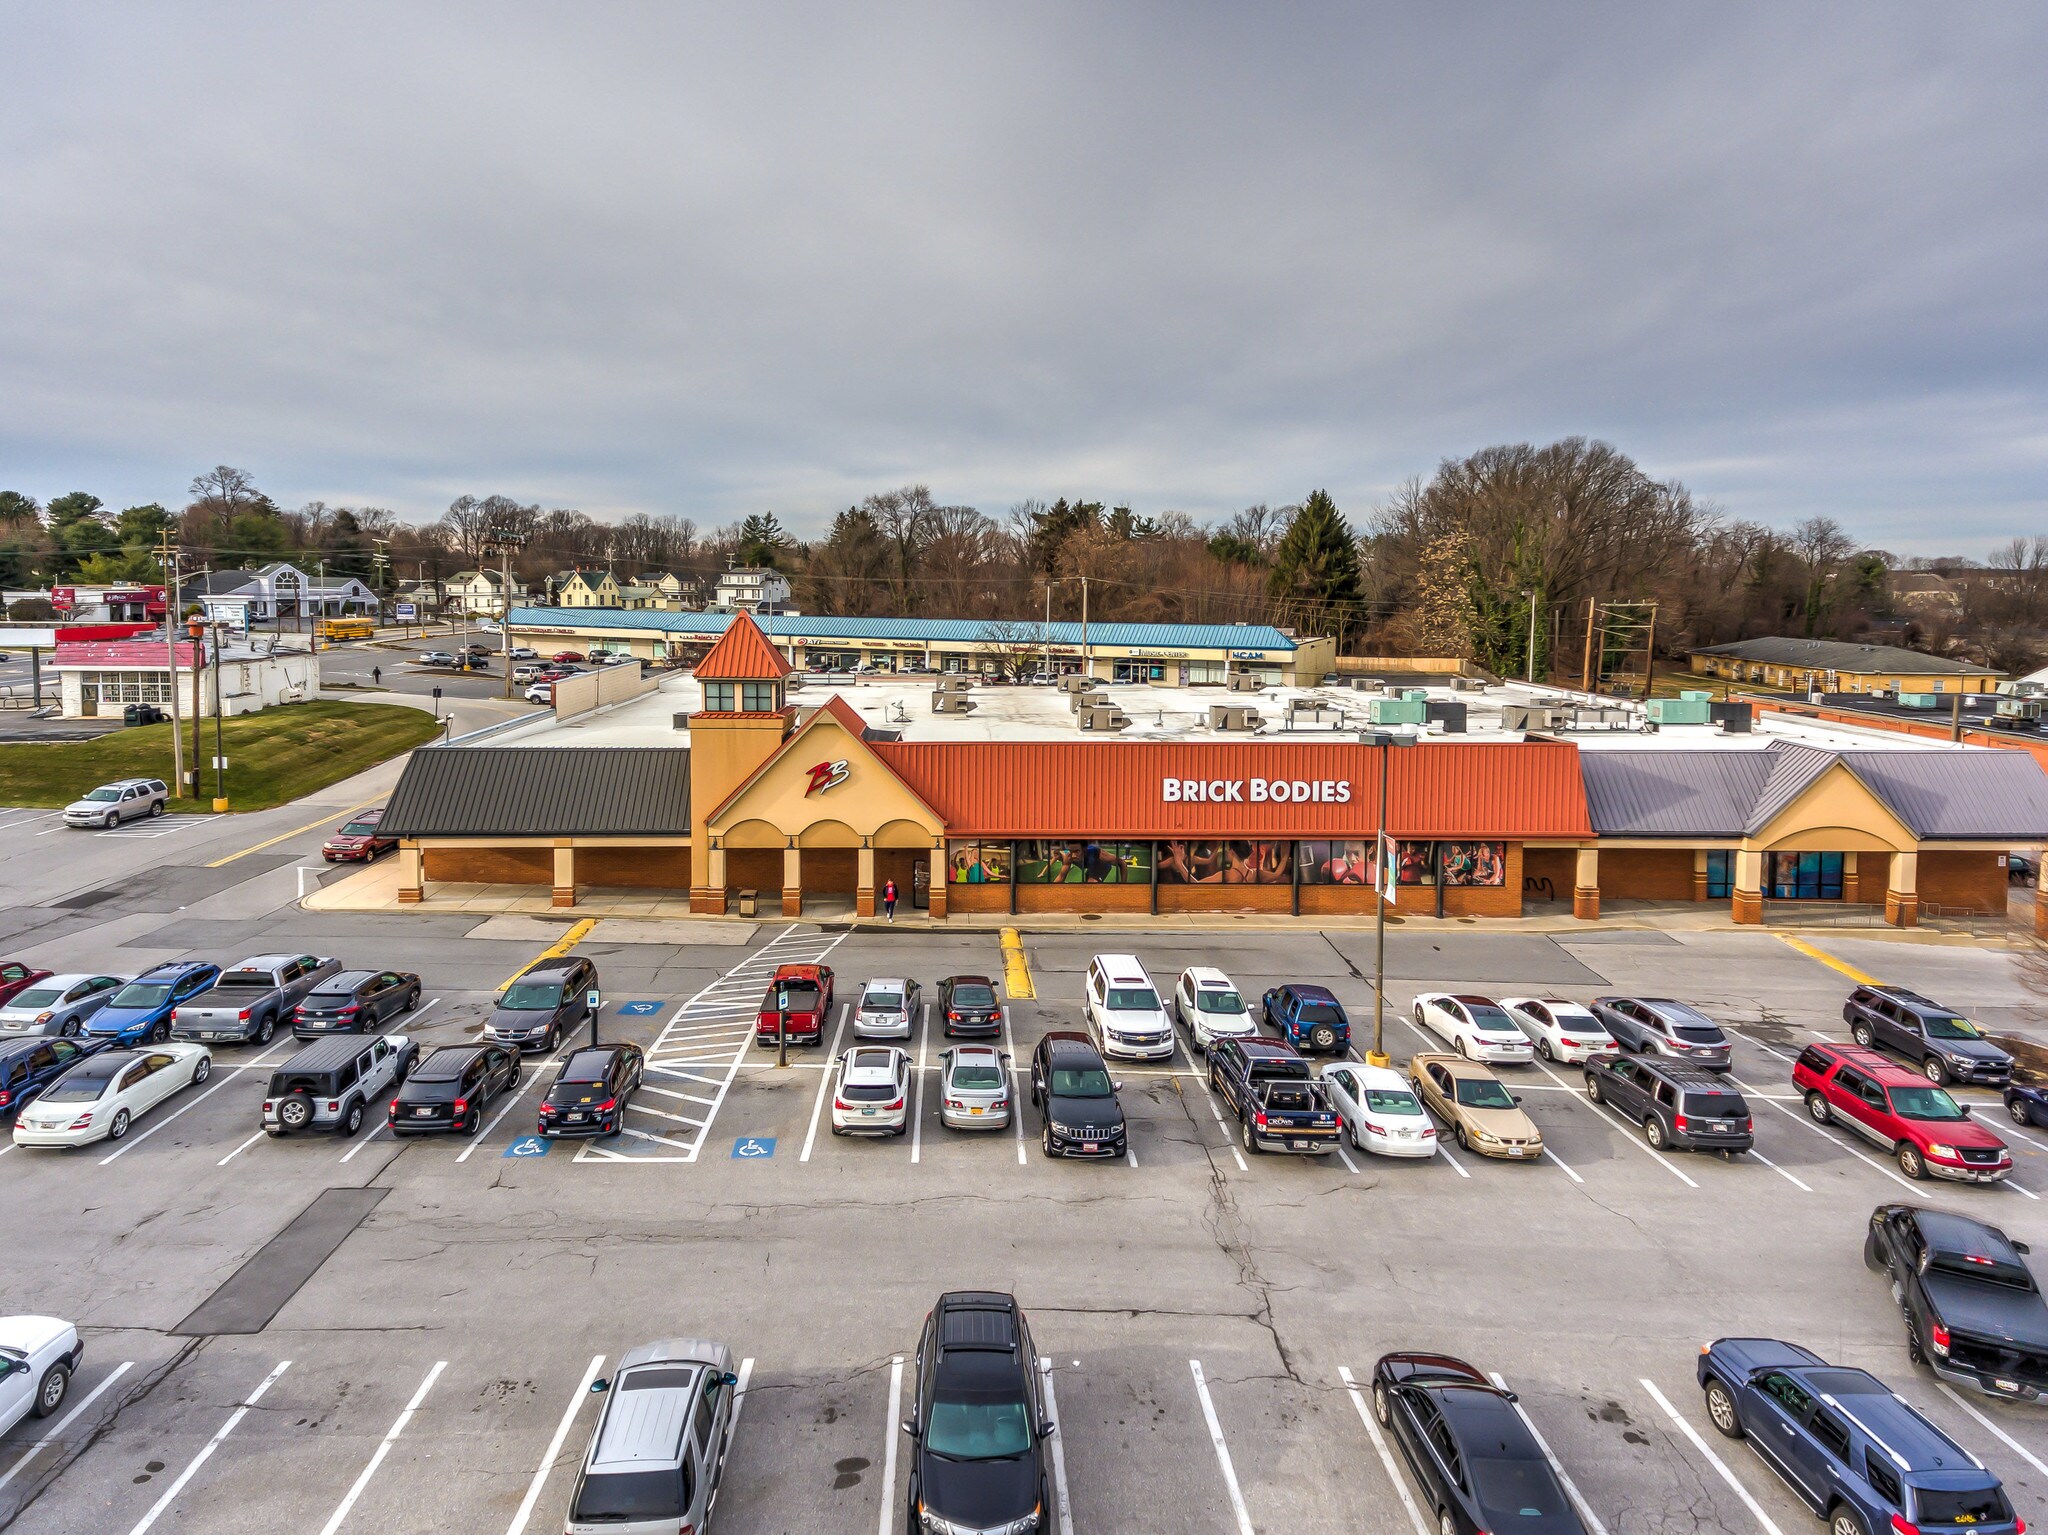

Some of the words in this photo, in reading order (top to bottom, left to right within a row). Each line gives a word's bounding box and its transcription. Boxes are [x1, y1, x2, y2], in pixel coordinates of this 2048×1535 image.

[1162, 777, 1245, 803] BRICK
[1250, 777, 1352, 804] BODIES
[1267, 1118, 1294, 1126] CROWN
